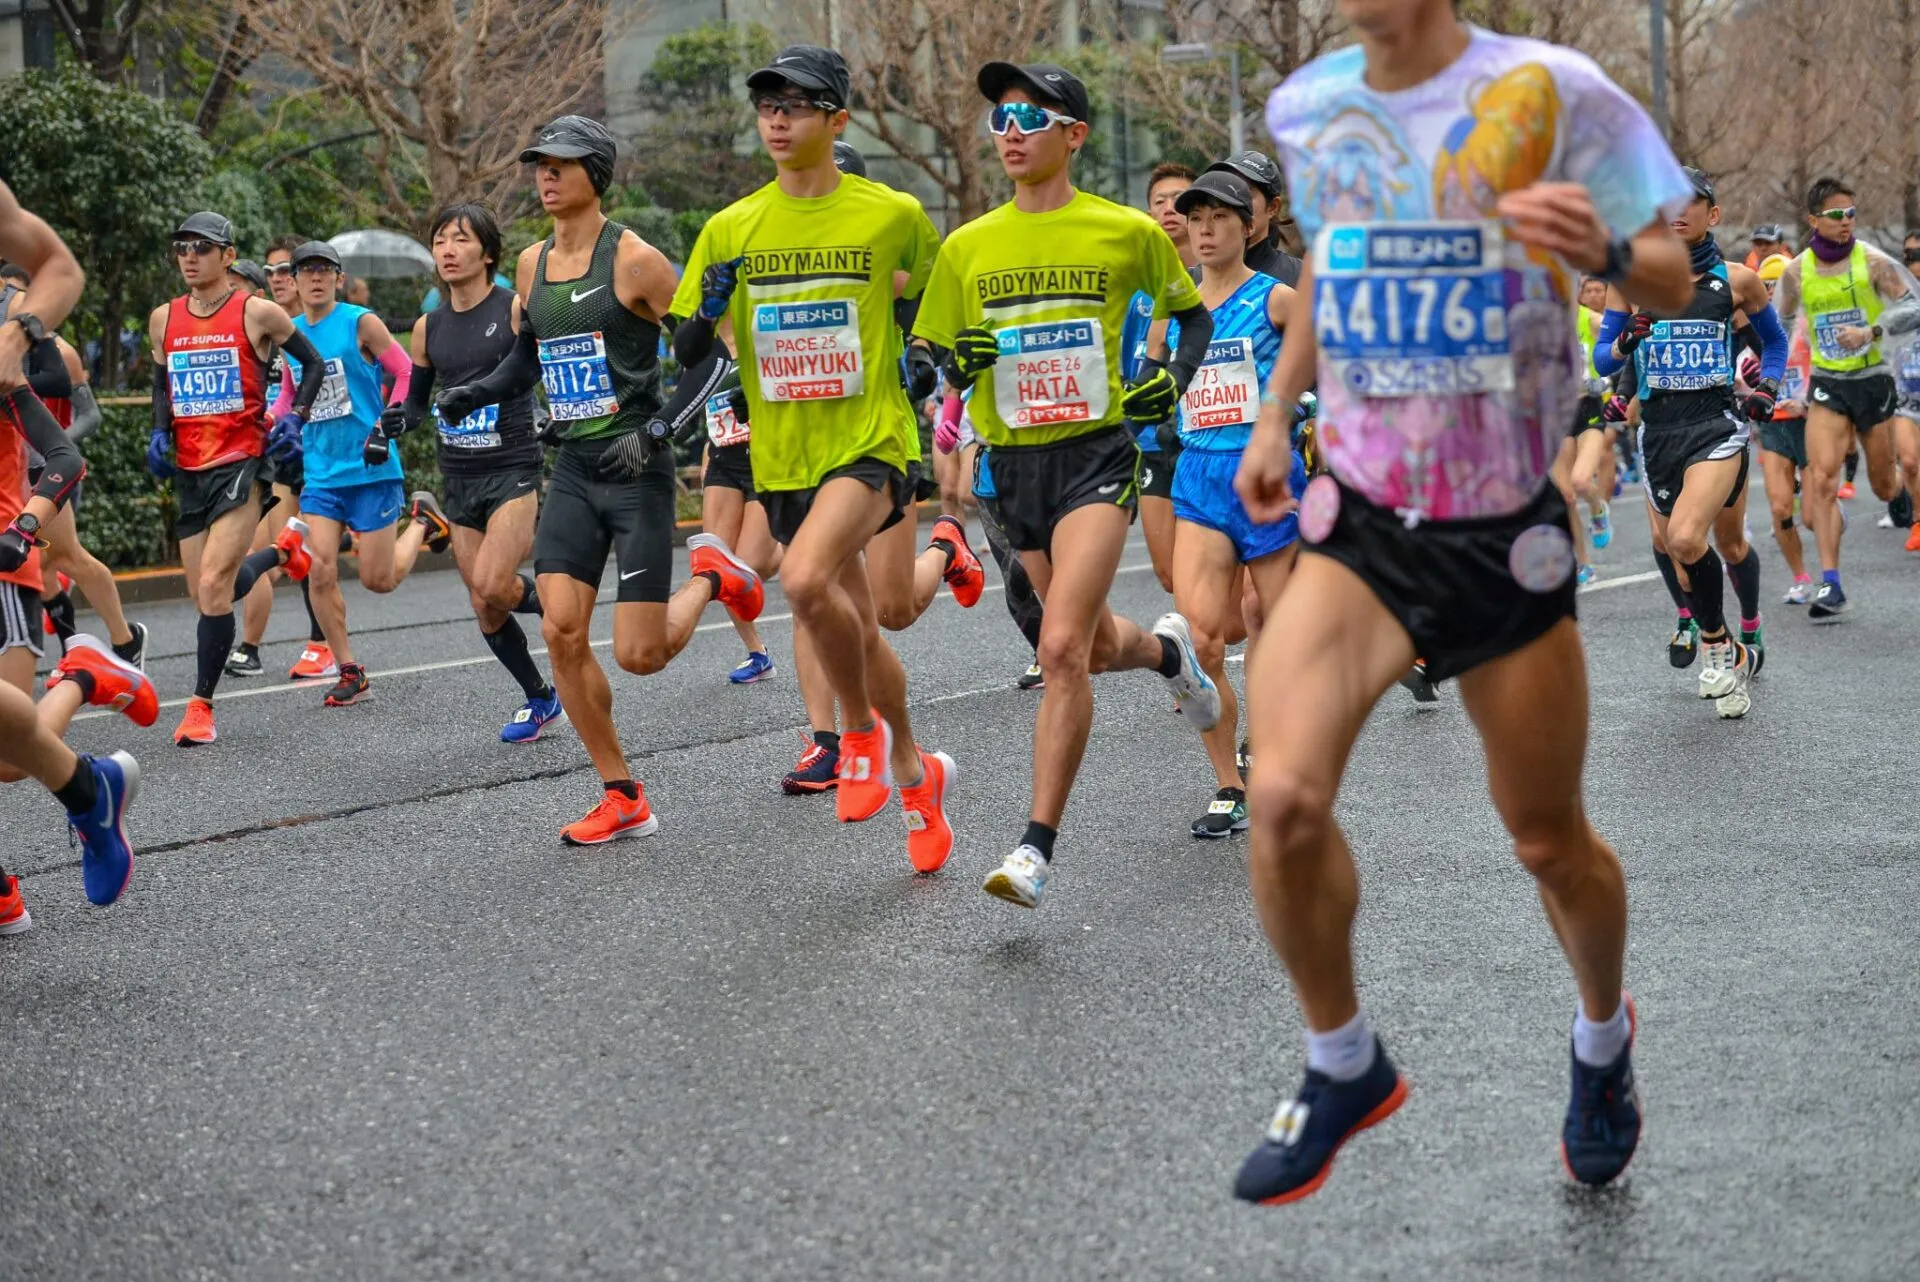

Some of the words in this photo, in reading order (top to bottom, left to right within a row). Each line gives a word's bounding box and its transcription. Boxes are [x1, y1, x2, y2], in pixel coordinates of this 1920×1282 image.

[744, 247, 872, 275] BODYMAINTÉ
[977, 267, 1109, 299] BODYMAINTÉ
[782, 308, 844, 324] 東京メトロ
[1317, 278, 1477, 344] A4176
[173, 334, 234, 347] MT.SUPOLA
[1024, 327, 1088, 347] 東京メトロ
[1672, 326, 1716, 336] 東京メトロ
[776, 337, 818, 353] PACE
[821, 335, 837, 350] 25
[1204, 346, 1240, 360] 京メトロ
[760, 351, 857, 378] KUNIYUKI
[1647, 342, 1715, 369] A4304
[1017, 358, 1061, 376] PACE
[1065, 357, 1081, 371] 26
[172, 369, 228, 397] A4907
[1201, 368, 1218, 385] 73
[791, 382, 841, 396] ヤマザキ
[1017, 375, 1081, 402] HATA
[1185, 383, 1248, 411] NOGAMI
[1033, 404, 1086, 420] ヤマザキ
[1200, 411, 1240, 425] ヤマザキ
